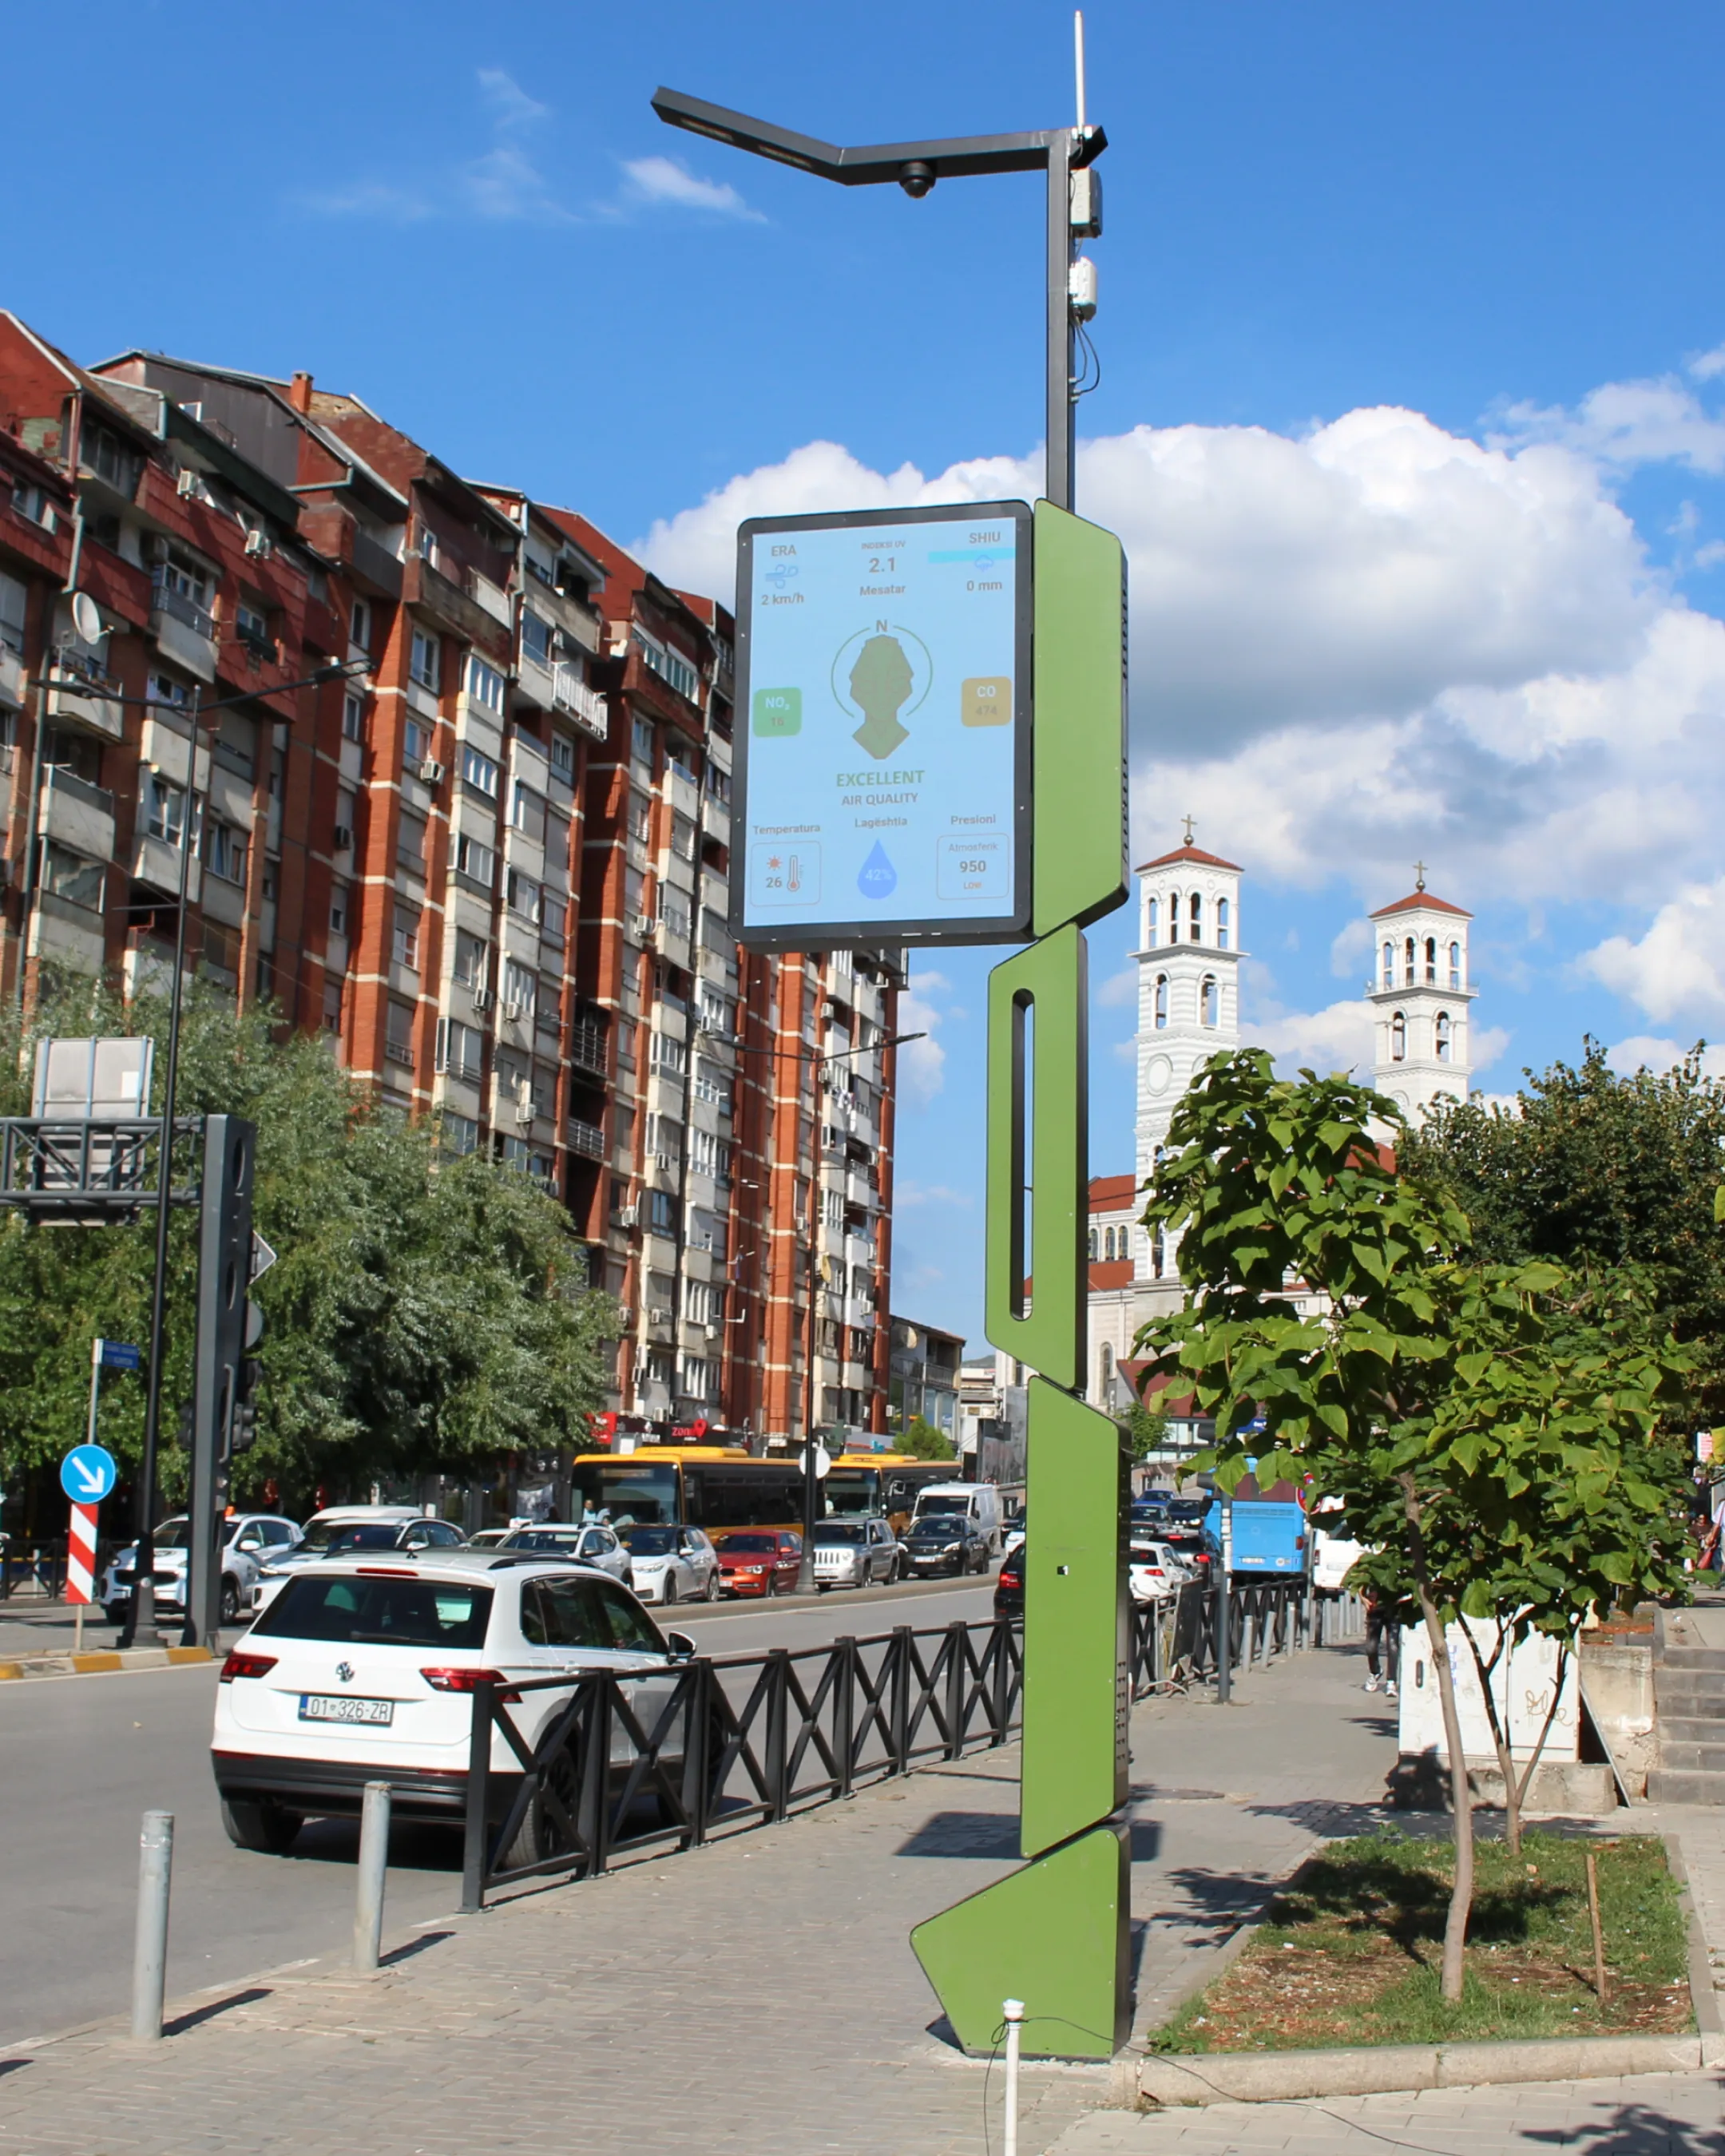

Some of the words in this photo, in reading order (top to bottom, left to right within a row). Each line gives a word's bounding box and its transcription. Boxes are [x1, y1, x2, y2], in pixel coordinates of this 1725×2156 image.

[969, 531, 1001, 545] SHIU
[771, 544, 797, 557] ERA
[868, 557, 895, 573] 2.1
[859, 584, 906, 596] Mesatar
[966, 580, 975, 592] 0
[978, 581, 1002, 591] mm
[761, 594, 769, 606] 2
[772, 591, 805, 605] km/h
[875, 620, 888, 633] N
[836, 770, 926, 787] EXCELLENT
[841, 795, 862, 806] AIR
[866, 792, 918, 807] QUALITY
[752, 824, 821, 835] Temperatura
[959, 860, 986, 873] 950
[766, 877, 783, 888] 26
